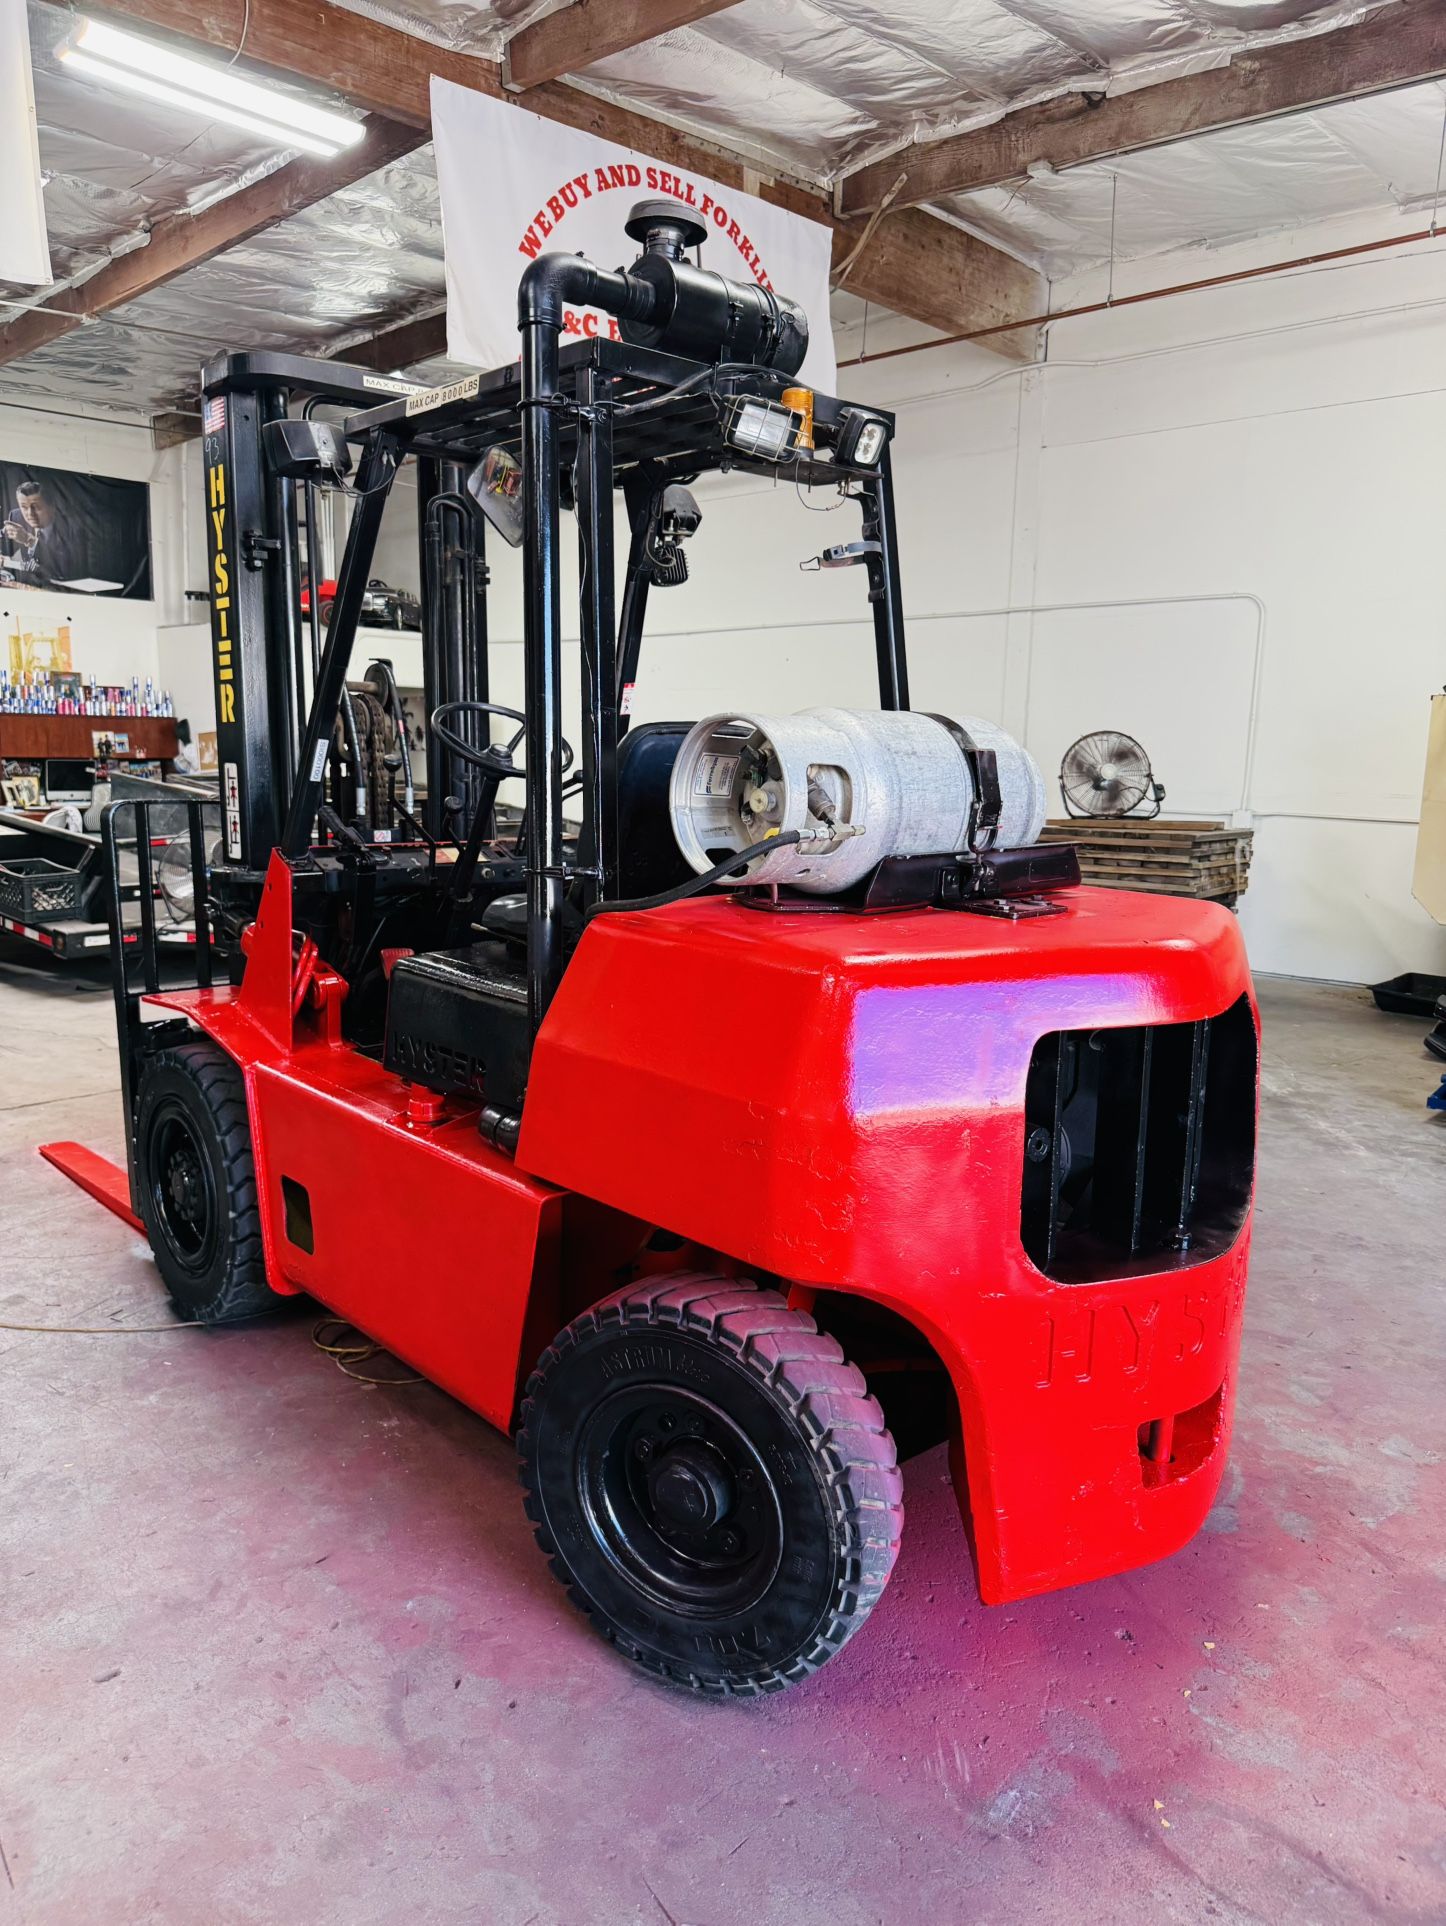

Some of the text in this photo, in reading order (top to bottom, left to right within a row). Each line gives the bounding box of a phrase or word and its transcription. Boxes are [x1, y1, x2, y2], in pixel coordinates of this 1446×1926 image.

[518, 209, 553, 259] WE
[546, 172, 592, 223] BUY
[594, 164, 641, 192] AND
[646, 166, 697, 206] SELL
[408, 398, 424, 410] MAX
[425, 392, 439, 406] CAP
[442, 387, 463, 401] 8000
[464, 379, 478, 393] LBS
[208, 463, 236, 723] HYSTER
